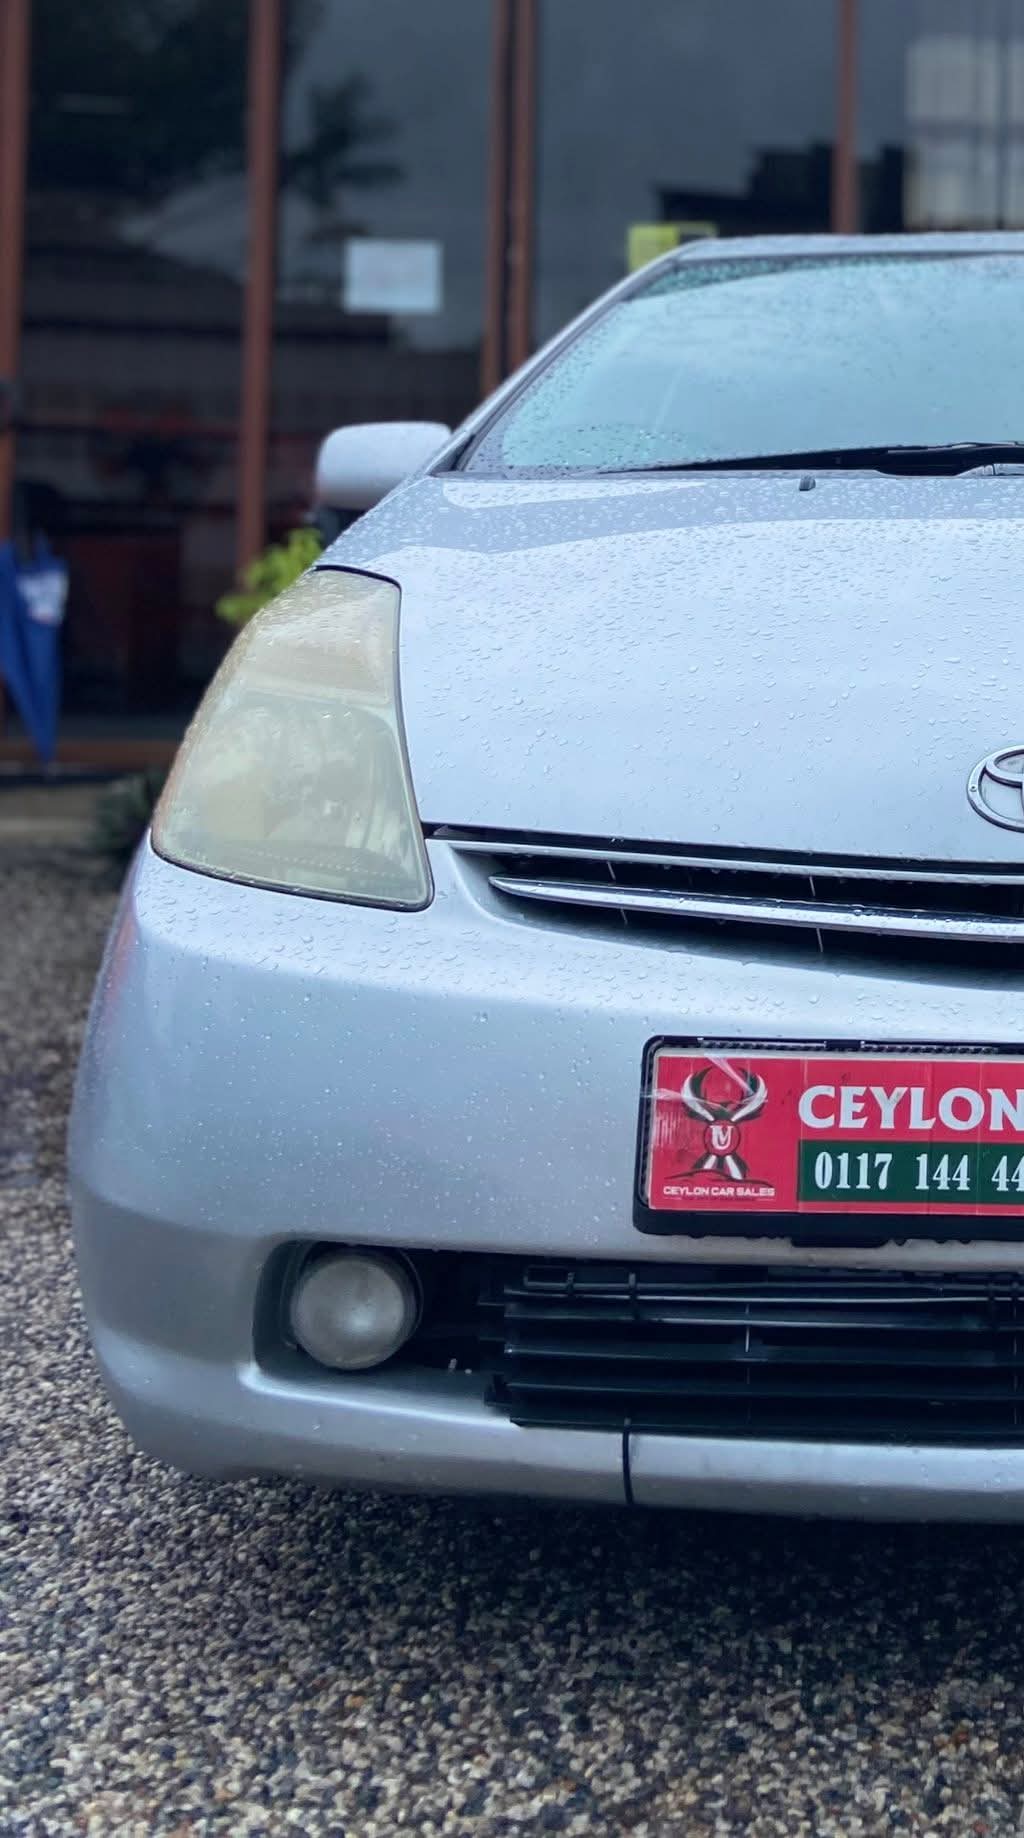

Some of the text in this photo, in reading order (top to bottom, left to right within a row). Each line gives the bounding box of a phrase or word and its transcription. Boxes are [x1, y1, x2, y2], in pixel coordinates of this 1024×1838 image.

[814, 1151, 893, 1190] 0117
[915, 1153, 970, 1191] 144
[663, 1186, 776, 1197] CEYLON CAR SALES
